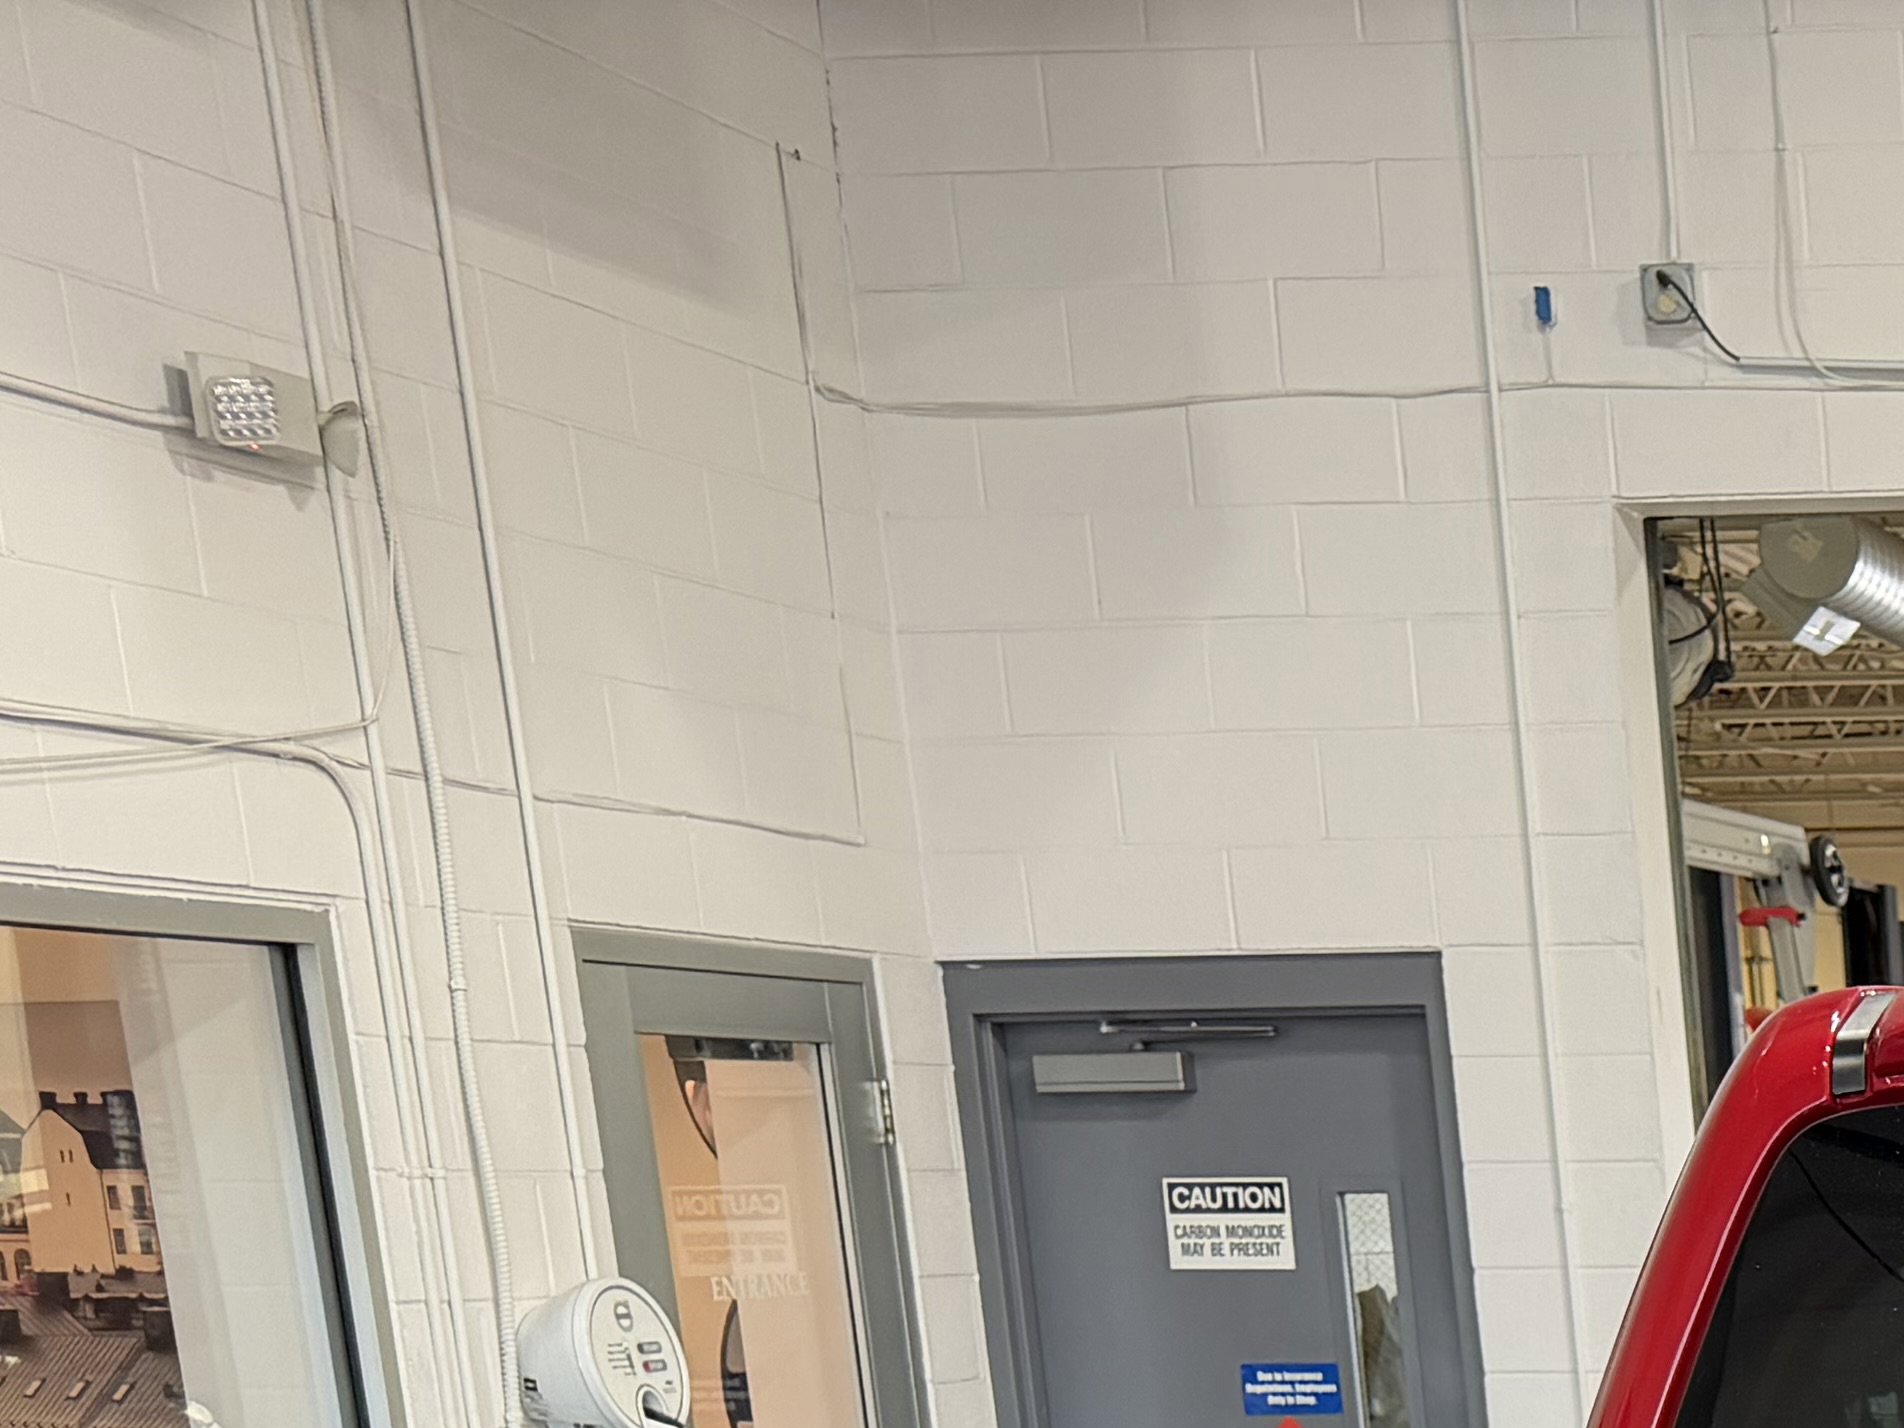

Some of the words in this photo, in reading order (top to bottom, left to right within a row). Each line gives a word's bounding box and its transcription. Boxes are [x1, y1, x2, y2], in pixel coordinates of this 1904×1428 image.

[1171, 1185, 1283, 1210] CAUTION
[1173, 1223, 1221, 1240] CARBON
[1224, 1223, 1286, 1240] MONOXIDE
[1180, 1242, 1206, 1257] MAY
[1210, 1242, 1226, 1257] BE
[1228, 1242, 1282, 1257] PRESENT
[711, 1271, 810, 1303] ENTRANCE
